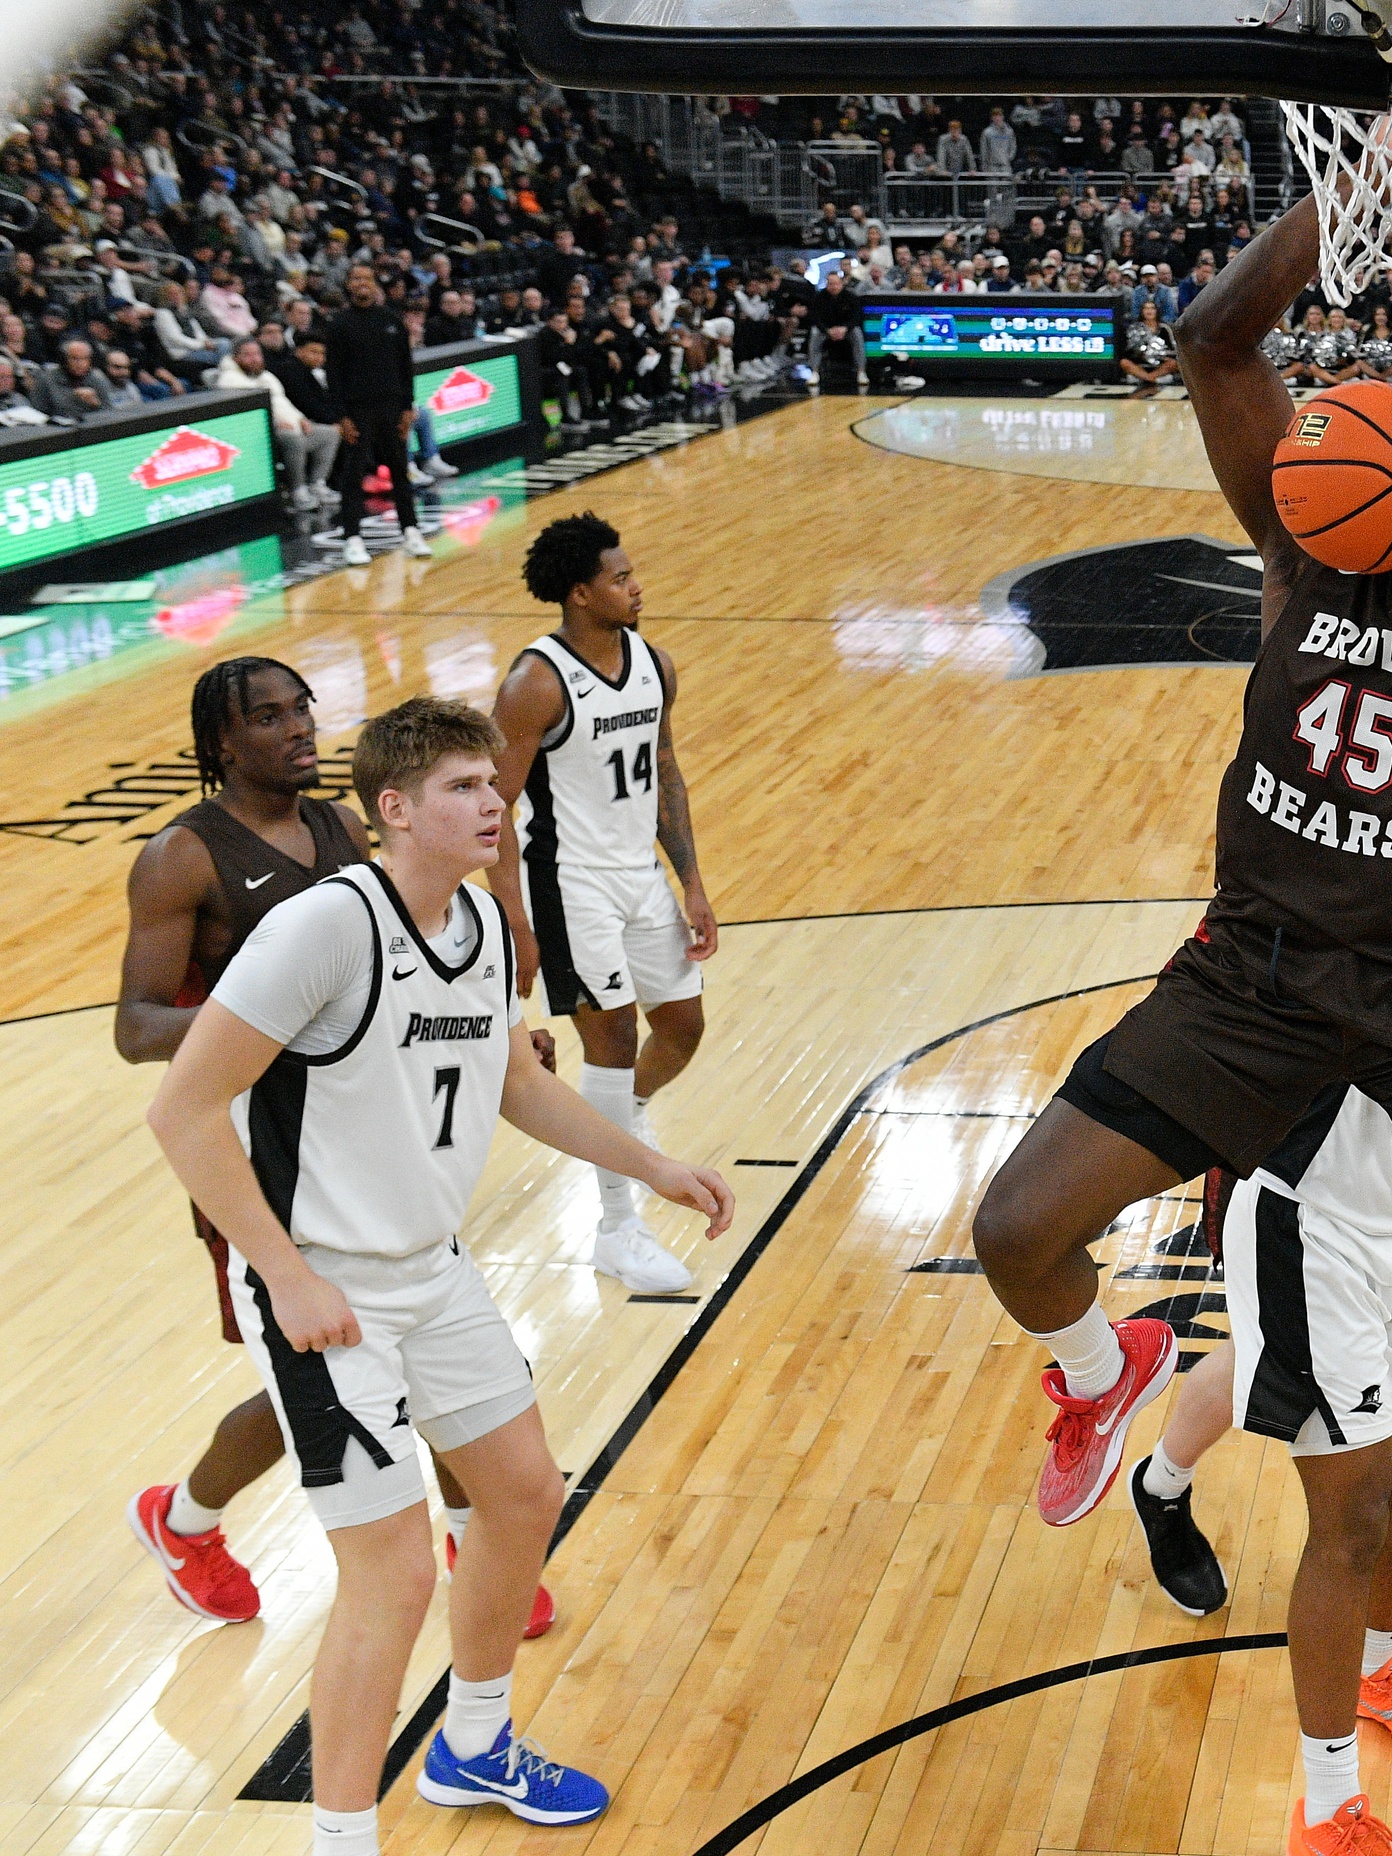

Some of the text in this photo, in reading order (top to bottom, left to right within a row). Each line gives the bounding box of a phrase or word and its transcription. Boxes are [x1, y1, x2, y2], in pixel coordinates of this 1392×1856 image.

[592, 706, 659, 741] PROVIDENCE
[604, 741, 652, 802] 14
[397, 1012, 493, 1048] PROVIDENCE
[431, 1064, 462, 1151] 7
